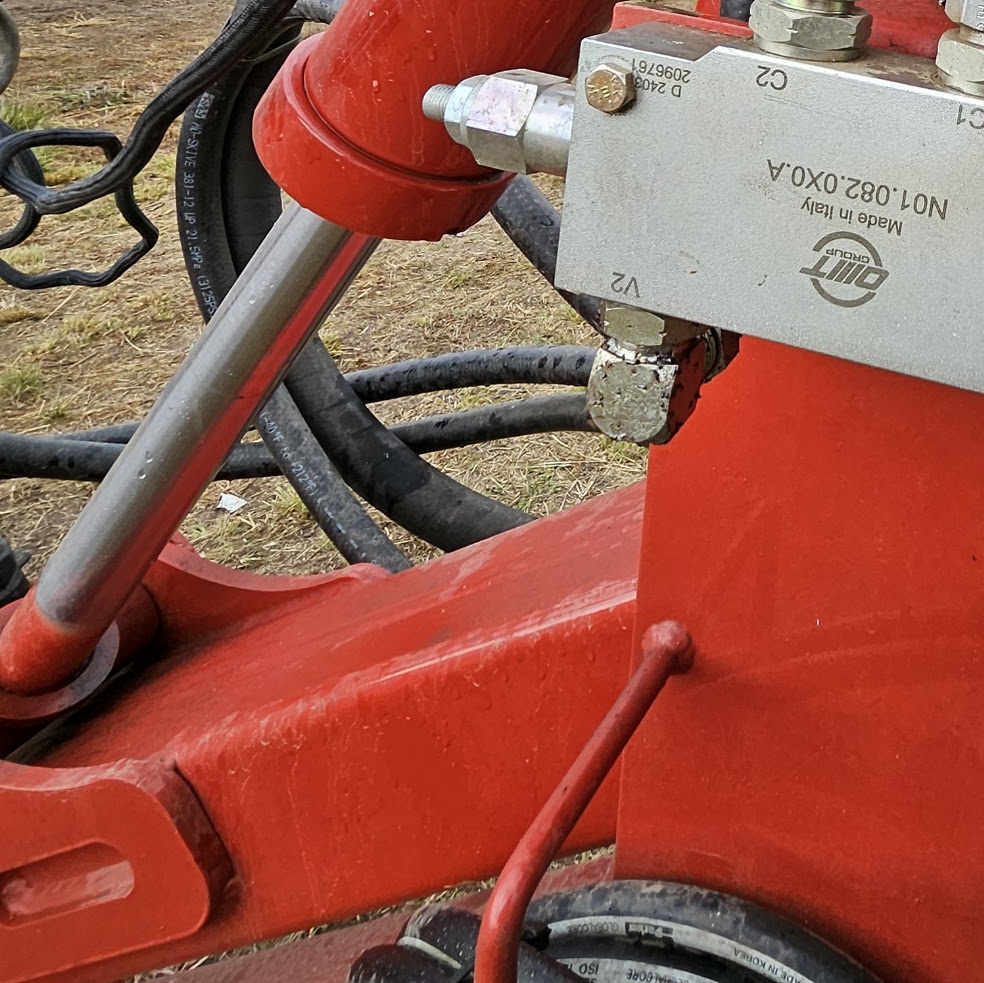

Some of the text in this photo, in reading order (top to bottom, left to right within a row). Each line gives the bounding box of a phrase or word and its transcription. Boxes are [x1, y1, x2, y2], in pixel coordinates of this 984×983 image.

[632, 59, 691, 83] 2096761
[755, 65, 788, 91] C2
[671, 85, 682, 97] D
[184, 122, 203, 168] NO-SKIVE
[801, 197, 903, 236] Made in Italy
[826, 248, 869, 264] GROUP
[611, 272, 641, 298] V2
[579, 963, 599, 975] ISO
[733, 948, 766, 969] KOREA
[768, 966, 779, 975] IN
